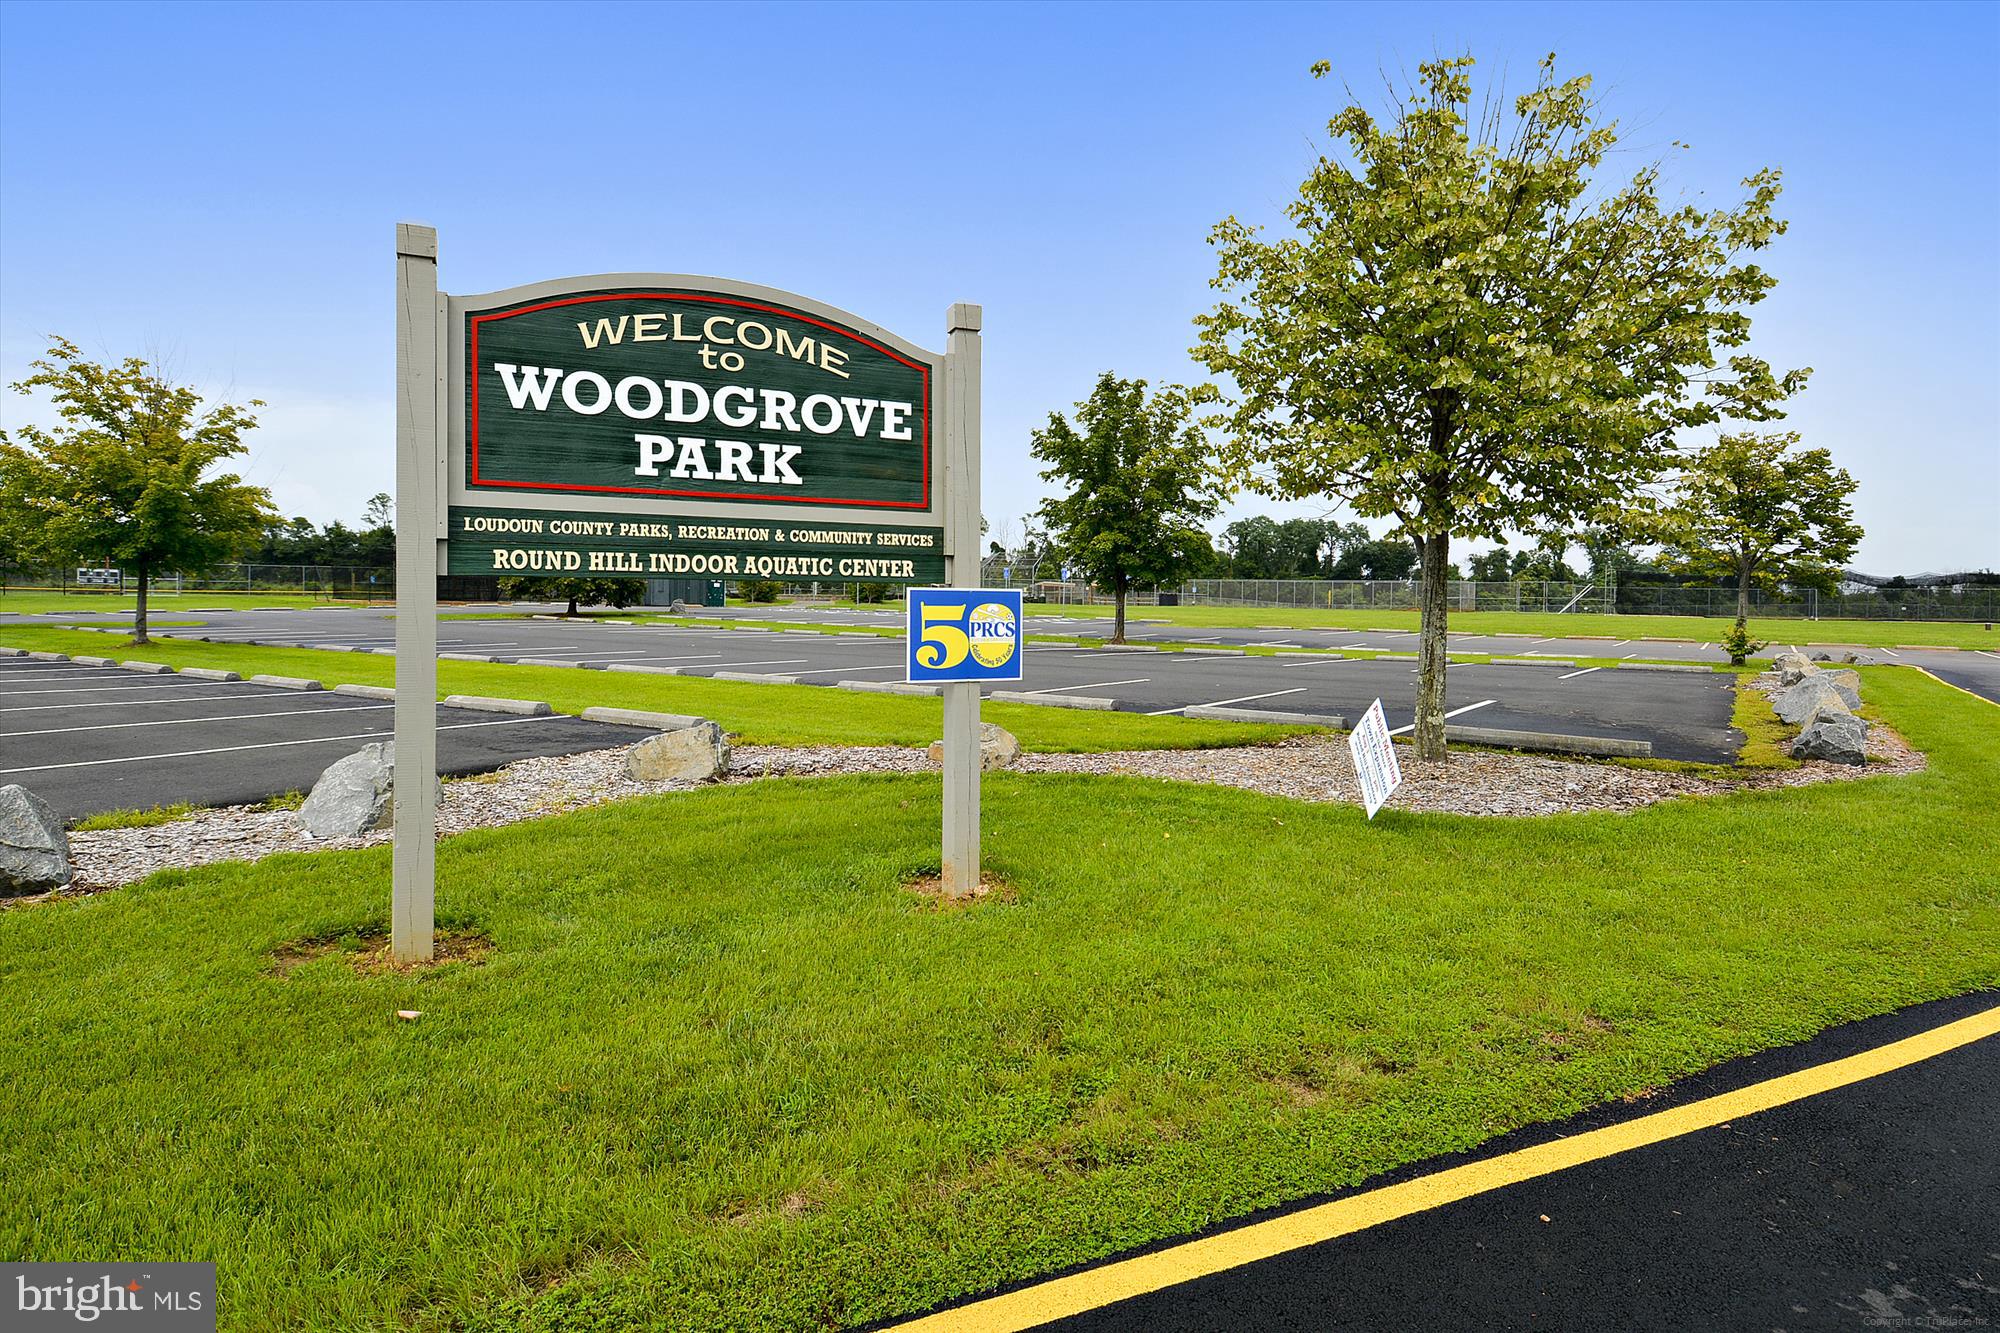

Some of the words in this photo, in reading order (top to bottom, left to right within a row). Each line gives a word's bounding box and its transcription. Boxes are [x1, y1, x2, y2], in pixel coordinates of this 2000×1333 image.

[577, 313, 850, 379] WELCOME
[698, 343, 745, 372] to
[494, 362, 913, 441] WOODGROVE
[634, 433, 803, 485] PARK
[463, 516, 544, 533] LOUDOUN
[550, 520, 614, 536] COUNTY
[619, 523, 673, 540] PARKS,
[678, 525, 770, 542] RECREATION
[774, 530, 785, 542] &
[789, 529, 873, 546] COMMUNITY
[876, 533, 934, 547] SERVICES
[492, 549, 581, 571] ROUND
[588, 552, 644, 572] HILL
[649, 553, 739, 574] INDOOR
[743, 555, 833, 578] AQUATIC
[838, 558, 915, 578] CENTER
[970, 621, 1015, 638] PRCS
